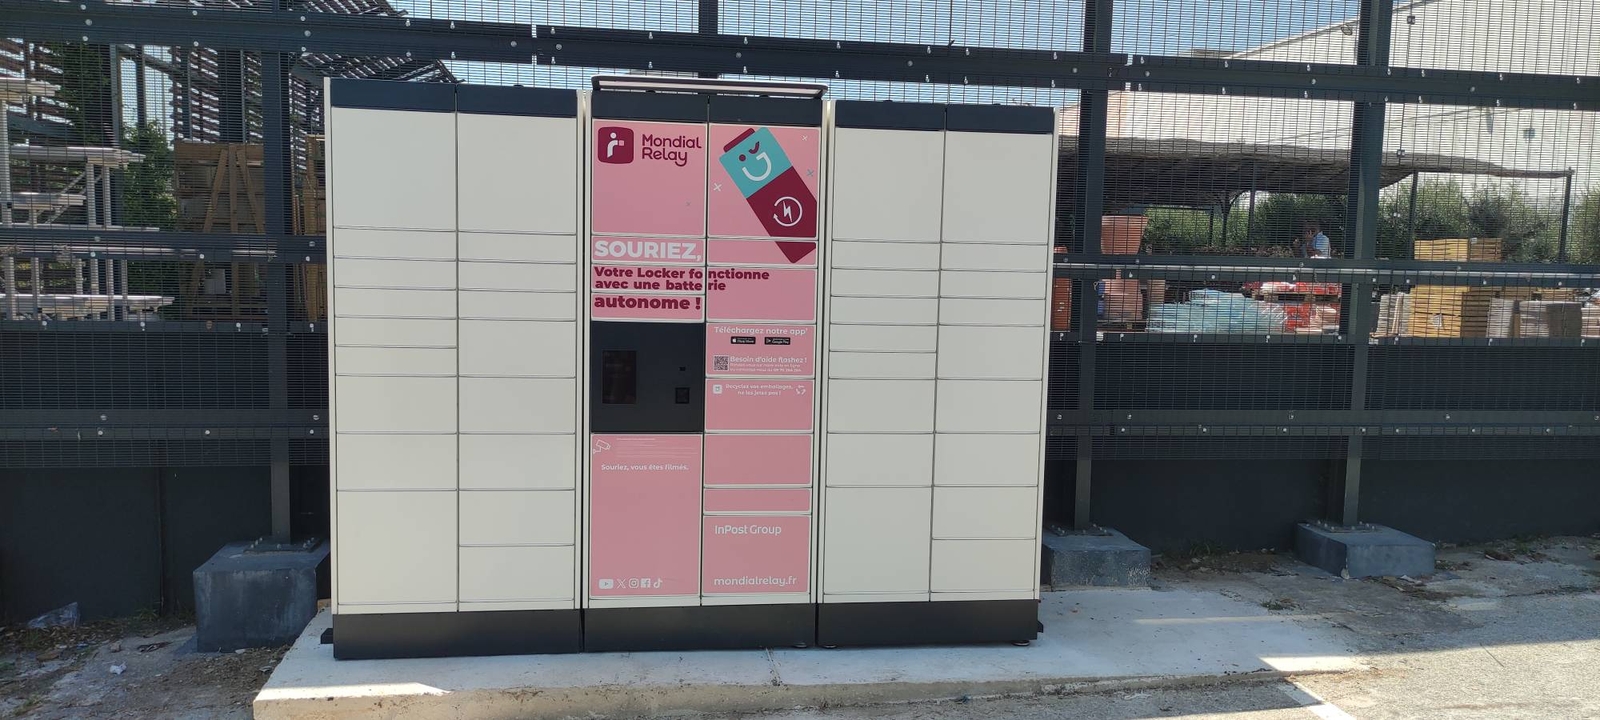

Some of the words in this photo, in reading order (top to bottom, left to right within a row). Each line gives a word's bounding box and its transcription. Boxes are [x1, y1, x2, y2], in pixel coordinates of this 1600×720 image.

[642, 134, 702, 148] Mondial
[642, 147, 688, 166] Relay
[594, 240, 702, 262] SOURIEZ,
[594, 266, 634, 278] Votre
[637, 268, 685, 278] Locker
[594, 280, 629, 289] avec
[634, 281, 660, 290] une
[594, 296, 691, 310] autonome
[695, 297, 702, 310] !
[714, 326, 764, 336] Téléchargez
[714, 525, 748, 535] InPost
[750, 524, 782, 536] Group
[714, 575, 798, 587] mondialrelay.fr
